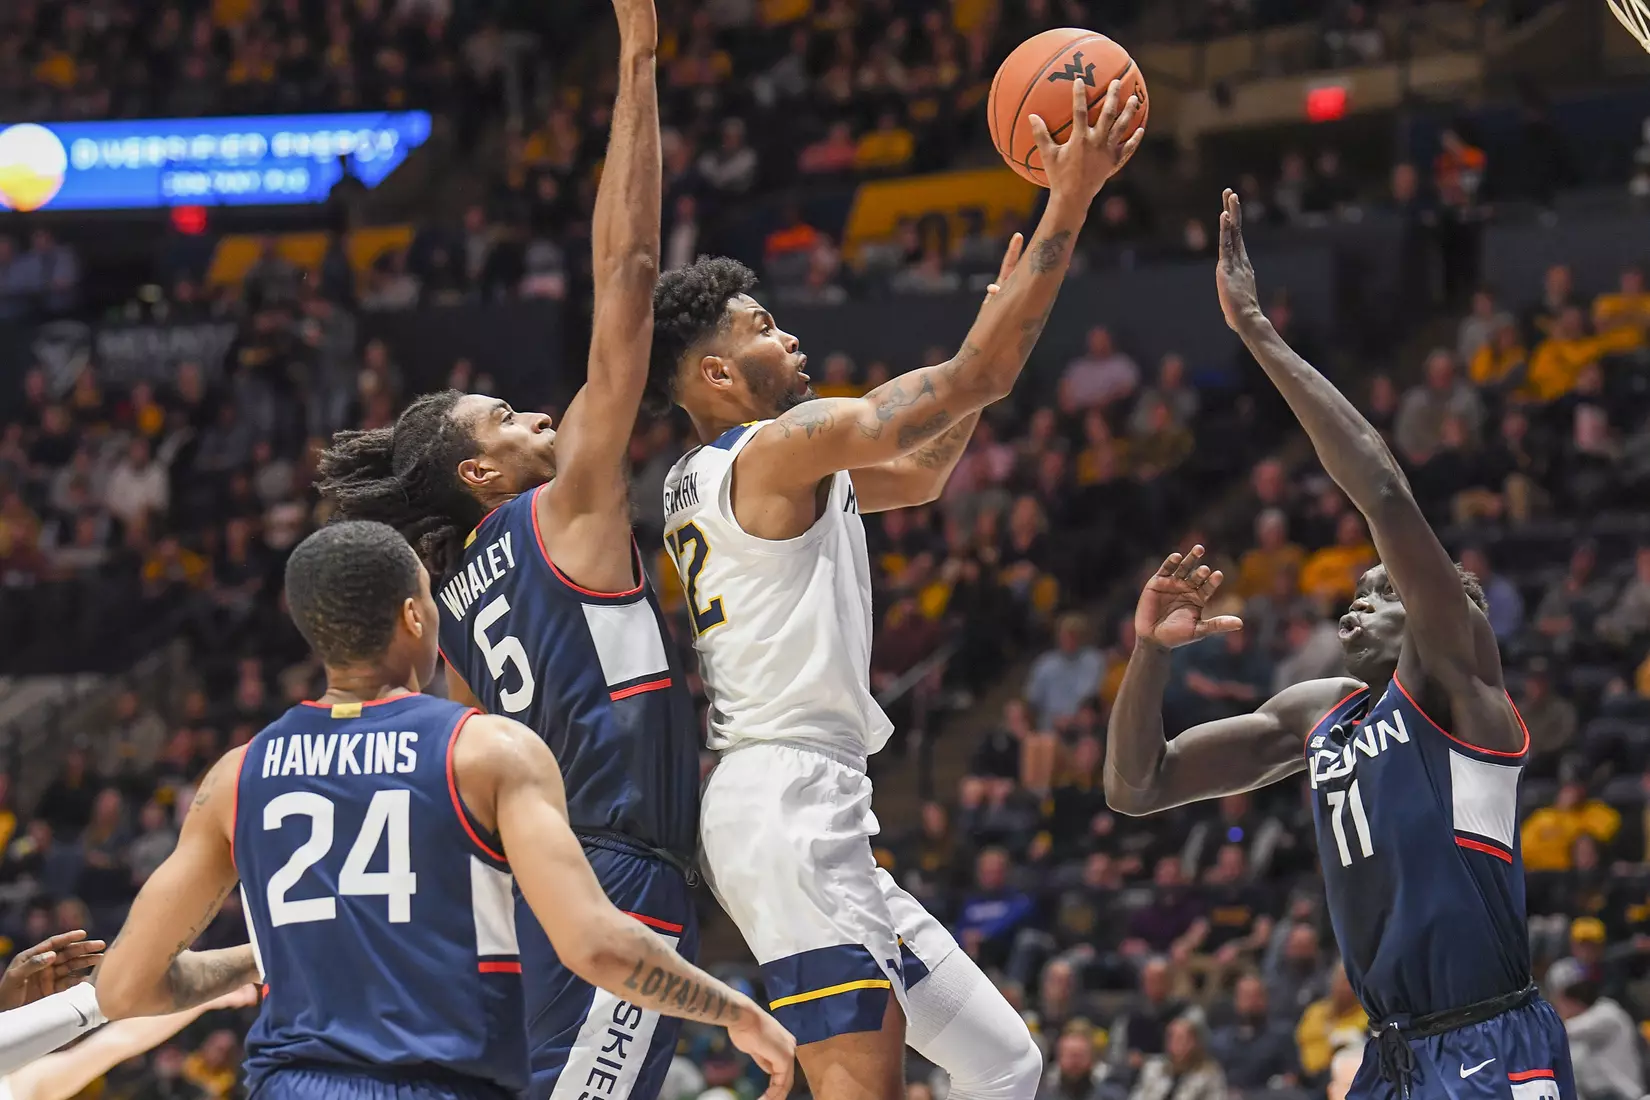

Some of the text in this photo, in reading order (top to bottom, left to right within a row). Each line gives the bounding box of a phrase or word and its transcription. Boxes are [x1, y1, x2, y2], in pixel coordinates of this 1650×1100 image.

[439, 531, 516, 622] WHALEY
[473, 593, 535, 713] 5
[261, 731, 419, 779] HAWKINS
[263, 789, 417, 928] 24
[1326, 778, 1375, 868] 11
